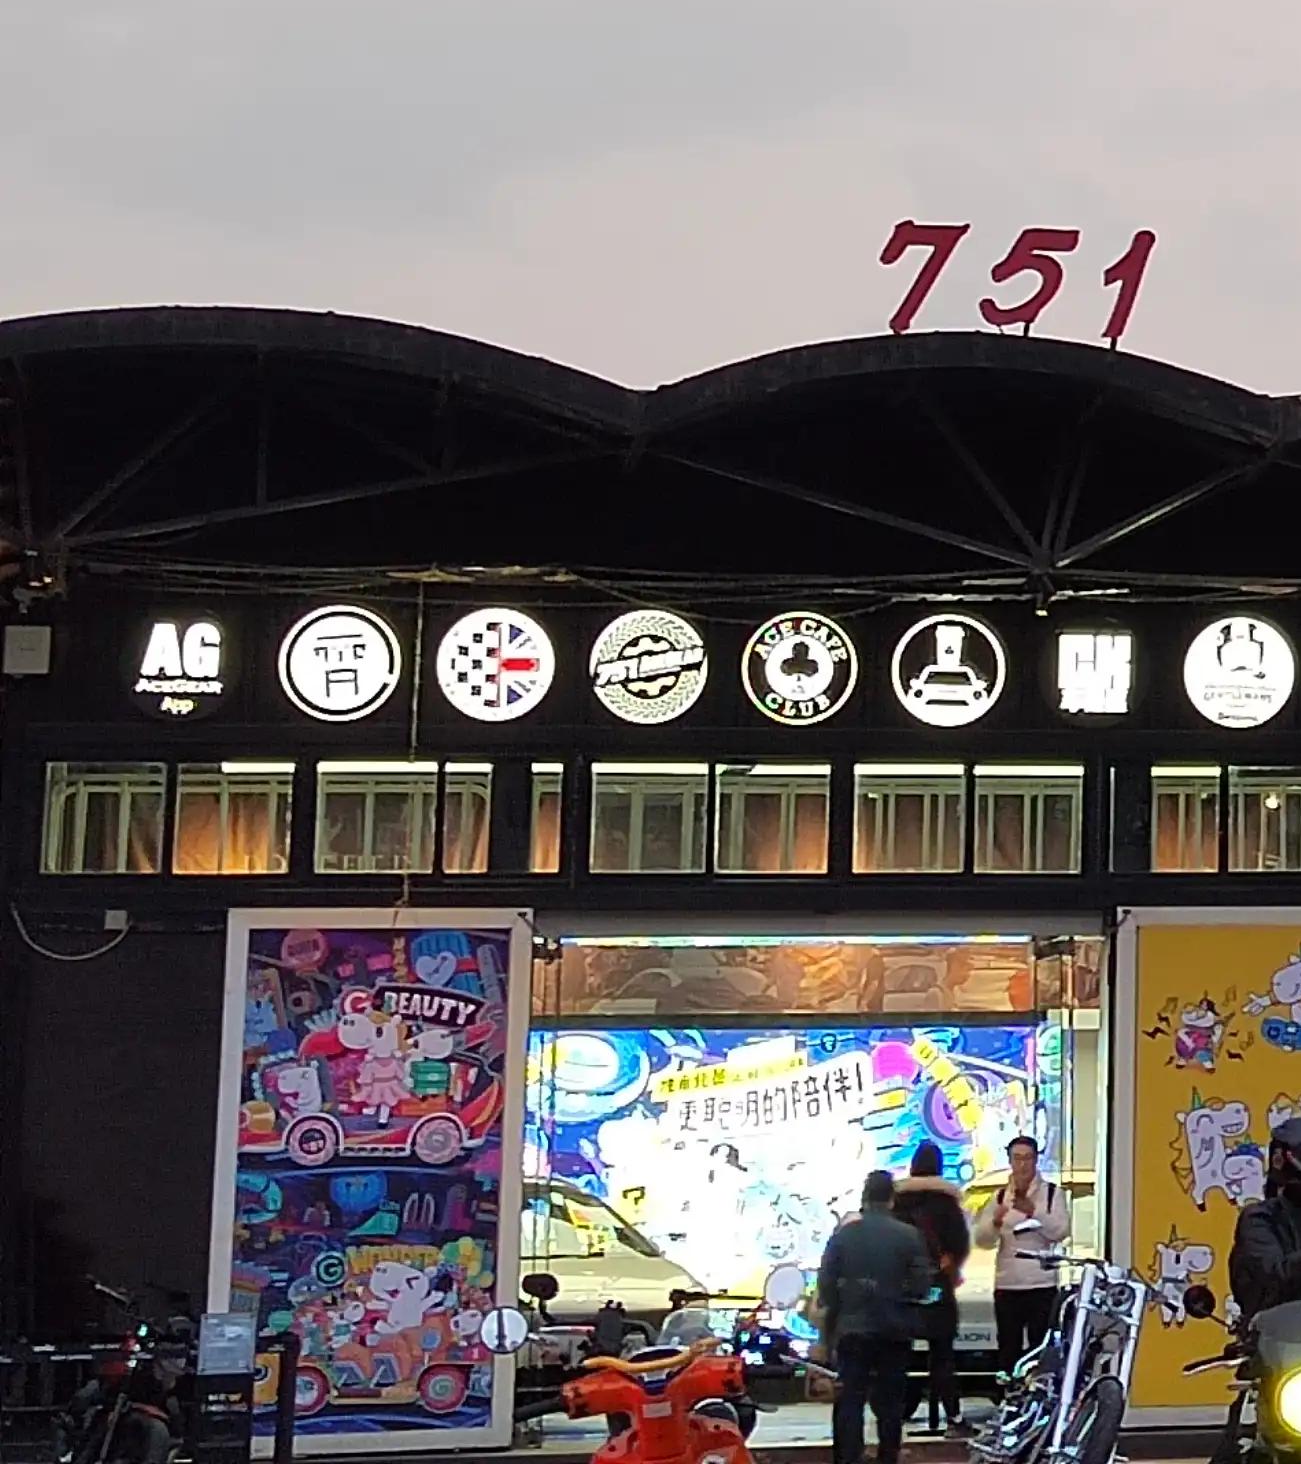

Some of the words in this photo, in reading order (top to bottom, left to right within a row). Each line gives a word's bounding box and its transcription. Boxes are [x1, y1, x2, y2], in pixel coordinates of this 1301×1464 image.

[879, 220, 1156, 338] 751
[140, 622, 221, 678] AG
[754, 621, 795, 661] ACE
[799, 619, 848, 663] CAFE
[764, 692, 831, 717] CLUB
[383, 991, 477, 1025] BEAUTY
